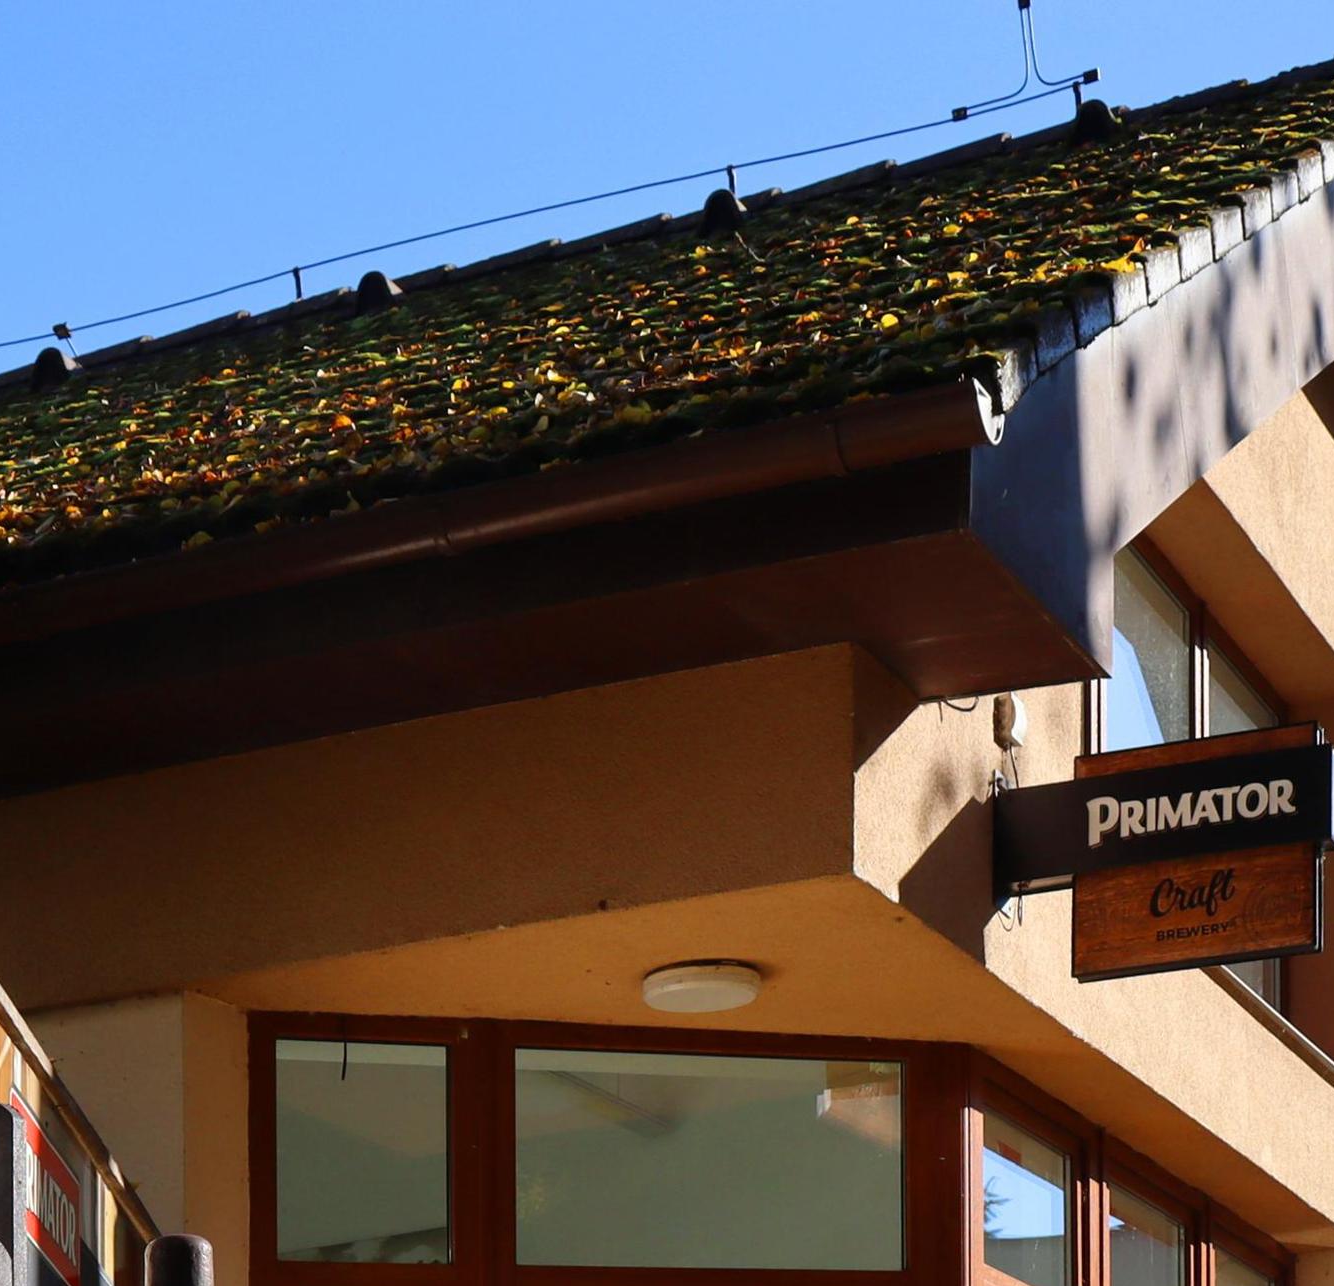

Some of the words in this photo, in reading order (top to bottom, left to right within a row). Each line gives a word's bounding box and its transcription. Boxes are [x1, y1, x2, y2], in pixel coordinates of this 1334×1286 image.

[1086, 779, 1297, 848] PRIMATOR
[1150, 868, 1236, 918] Craft
[1156, 921, 1231, 941] BREWERY
[26, 1140, 77, 1267] RIMATOR
